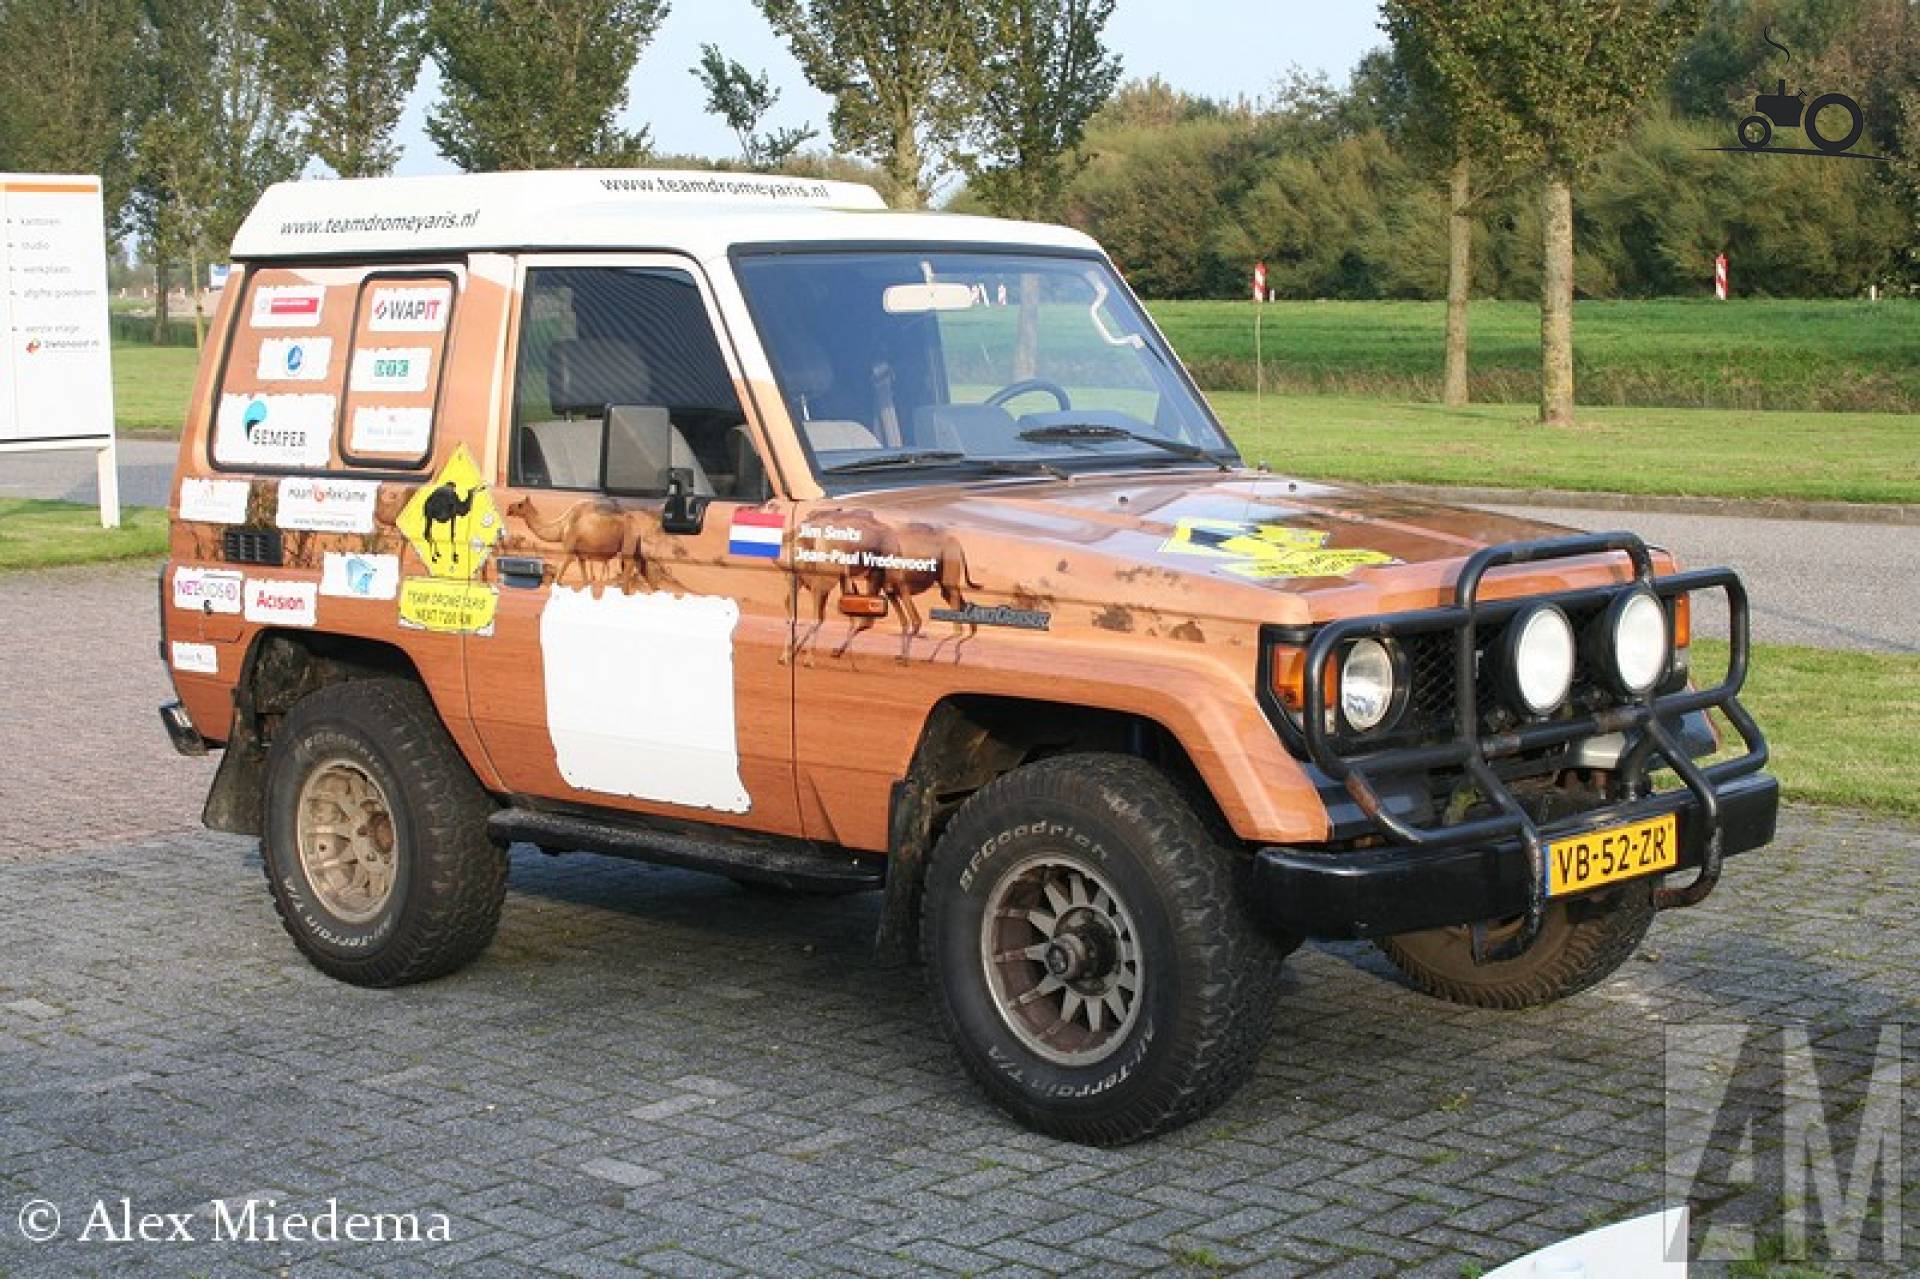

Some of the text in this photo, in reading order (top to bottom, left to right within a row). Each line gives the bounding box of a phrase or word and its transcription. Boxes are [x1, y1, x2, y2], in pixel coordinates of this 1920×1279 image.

[600, 176, 831, 200] www.teamdromeyaris.nl
[280, 208, 480, 235] www.teamdromeyaris.nl
[389, 300, 441, 321] WAPIT
[253, 428, 307, 448] SEMPER
[799, 525, 862, 541] Jim Smits
[795, 547, 860, 566] Jean-Paul
[256, 590, 306, 612] Acision
[959, 819, 1109, 893] BFGoodrich
[1556, 826, 1667, 885] VB-52-ZR
